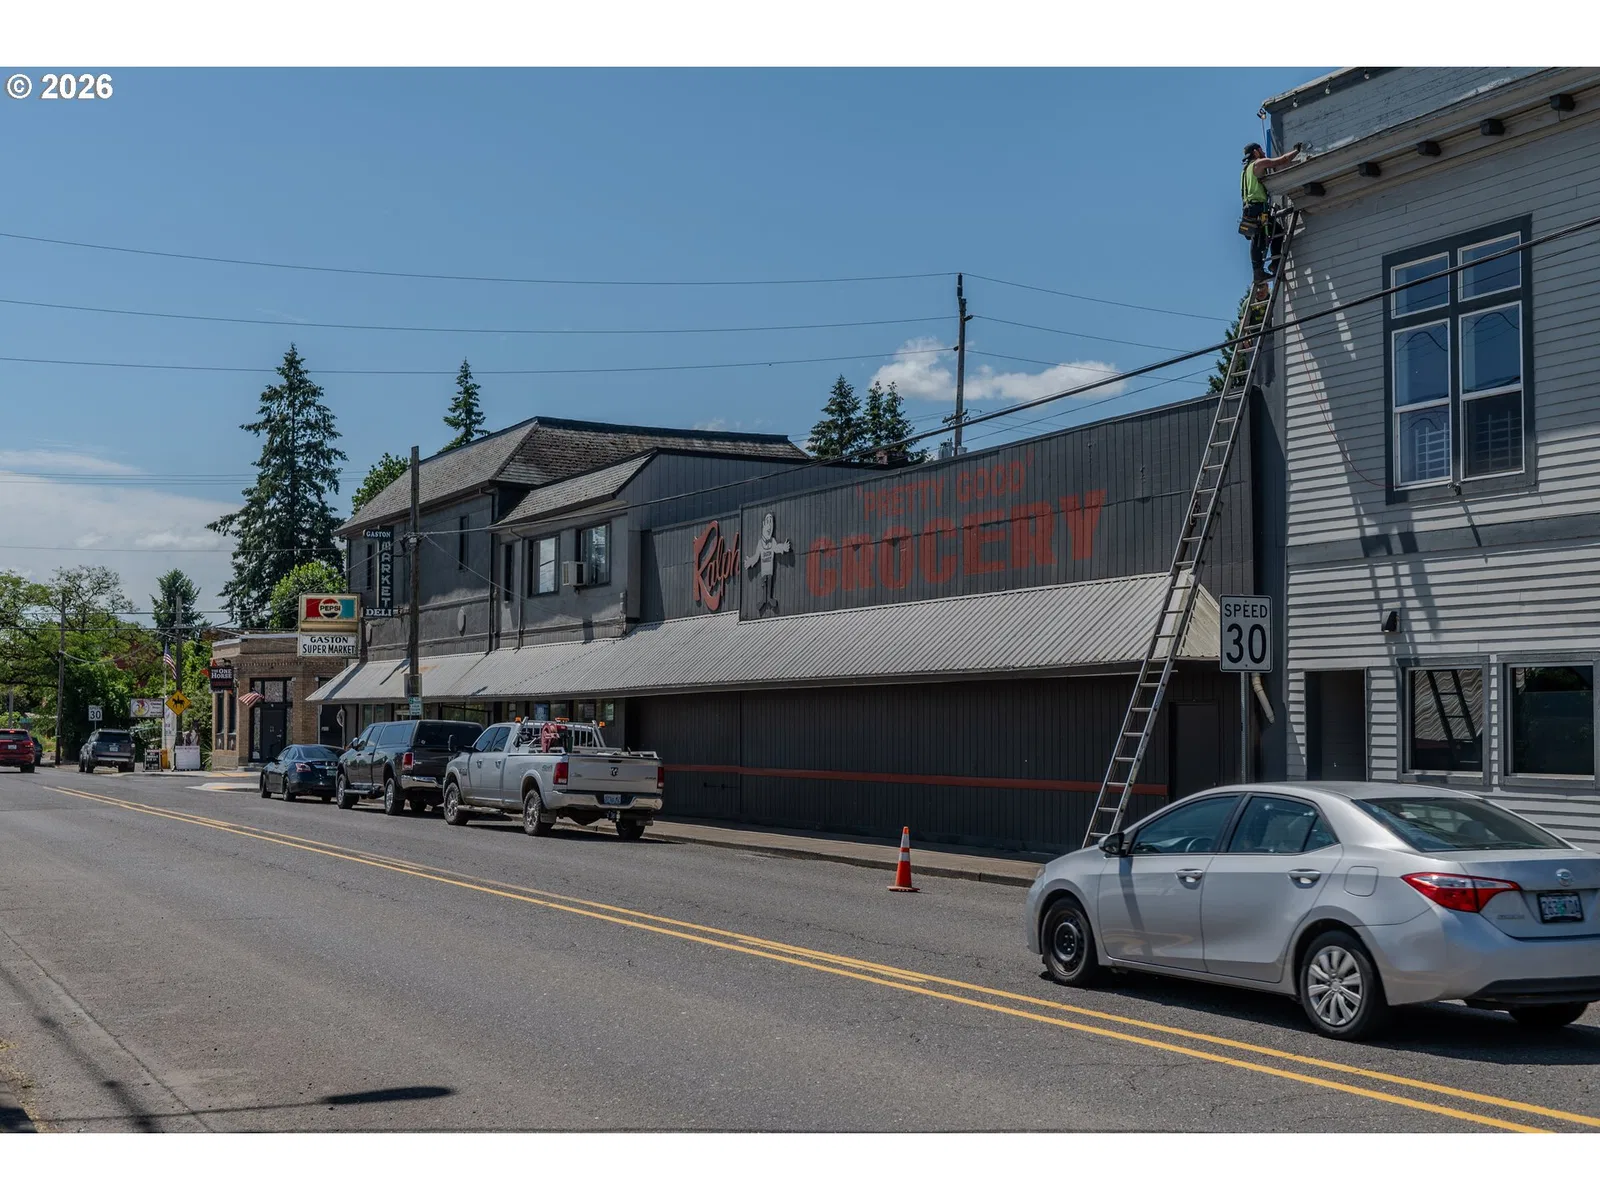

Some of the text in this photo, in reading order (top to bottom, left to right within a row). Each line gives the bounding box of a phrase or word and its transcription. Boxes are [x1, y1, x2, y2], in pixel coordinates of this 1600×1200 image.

[805, 489, 1108, 597] GROCERY
[693, 520, 740, 611] Ralph
[381, 541, 391, 607] MARKET
[365, 608, 392, 617] DELI
[1224, 603, 1268, 618] SPEED
[310, 636, 349, 644] GASTON
[1226, 622, 1267, 664] 30
[302, 644, 355, 654] SUPER MARKET
[90, 710, 102, 720] 30
